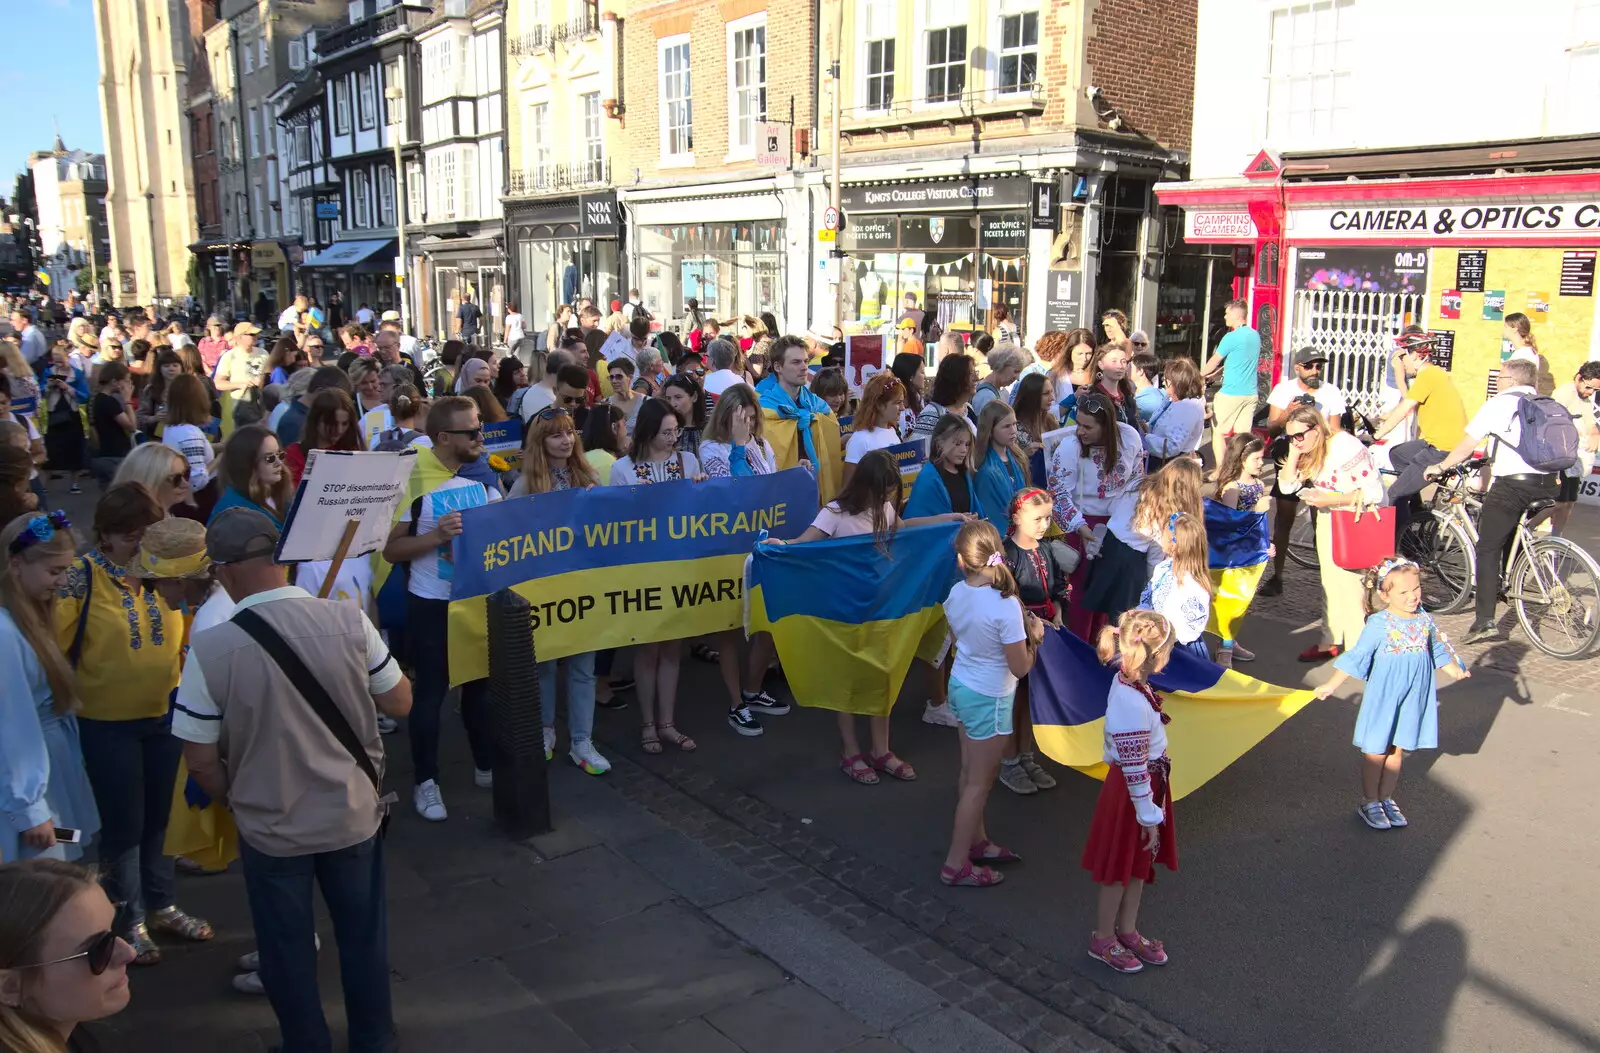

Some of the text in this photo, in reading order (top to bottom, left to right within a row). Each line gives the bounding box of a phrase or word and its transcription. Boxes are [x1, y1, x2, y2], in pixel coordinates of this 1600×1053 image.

[766, 126, 779, 135] Art
[757, 154, 788, 165] Gallery
[865, 191, 891, 203] KING'S
[892, 189, 926, 202] COLLEGE
[926, 188, 959, 200] VISITOR
[959, 186, 994, 198] CENTRE
[588, 213, 612, 225] NOA
[826, 213, 836, 224] 20
[1196, 215, 1250, 225] CAMPKINS
[1330, 204, 1600, 234] CAMERA & OPTICS C
[1001, 221, 1020, 229] OFFICE
[1204, 225, 1248, 234] CAMERAS
[984, 230, 1003, 238] TICKETS
[1011, 229, 1026, 237] GIFTS
[1395, 253, 1426, 267] OM-D
[895, 450, 916, 461] INING
[323, 484, 346, 492] STOP
[347, 483, 394, 492] dissemination
[317, 497, 349, 506] Russian
[443, 489, 480, 511] KYIV
[345, 508, 367, 516] NOW!
[483, 503, 787, 572] #STAND WITH UKRAINE
[530, 578, 743, 631] STOP THE WAR!
